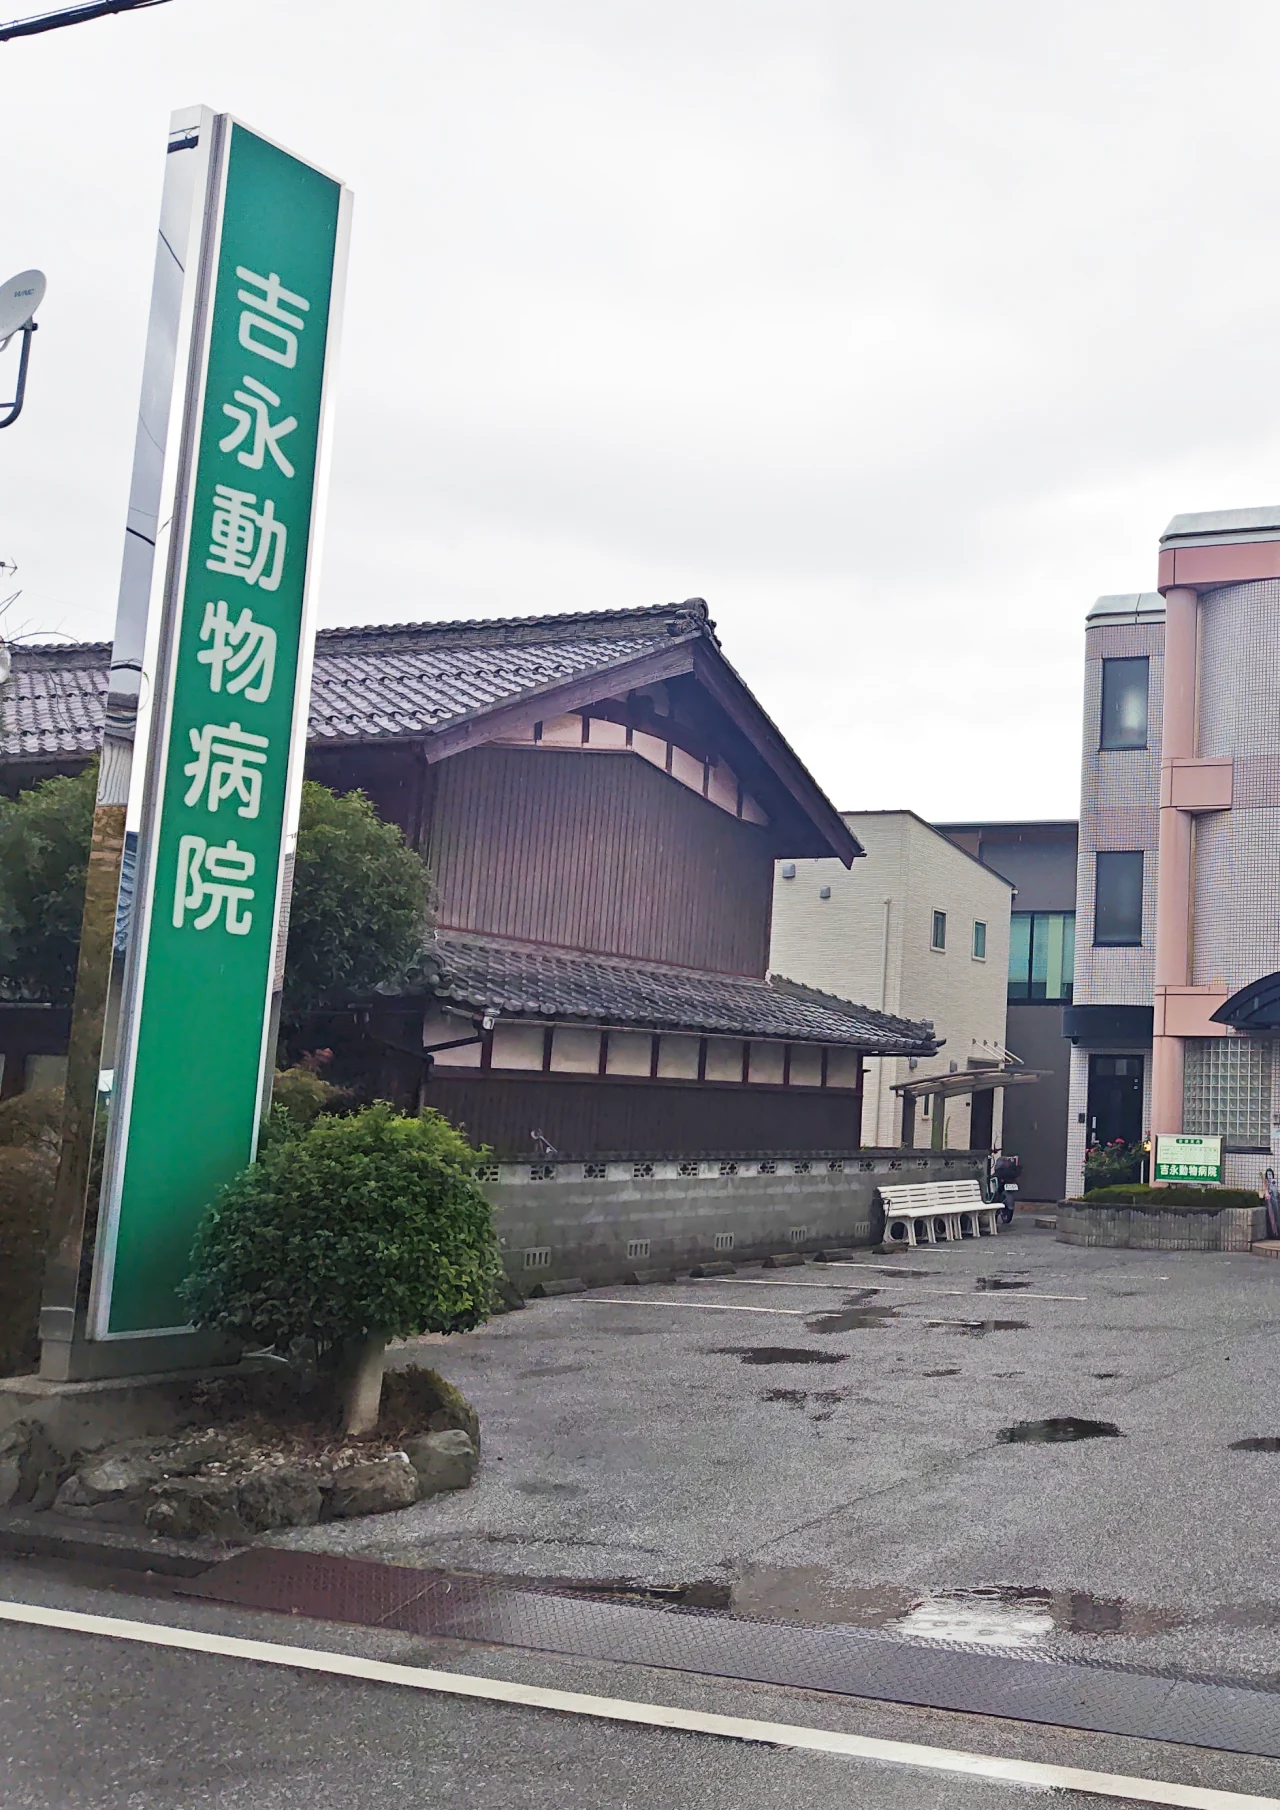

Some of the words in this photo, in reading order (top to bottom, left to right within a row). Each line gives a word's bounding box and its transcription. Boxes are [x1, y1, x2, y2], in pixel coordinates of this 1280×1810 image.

[173, 265, 310, 936] 吉永動物病院
[1159, 1163, 1218, 1178] 吉永動物病院
